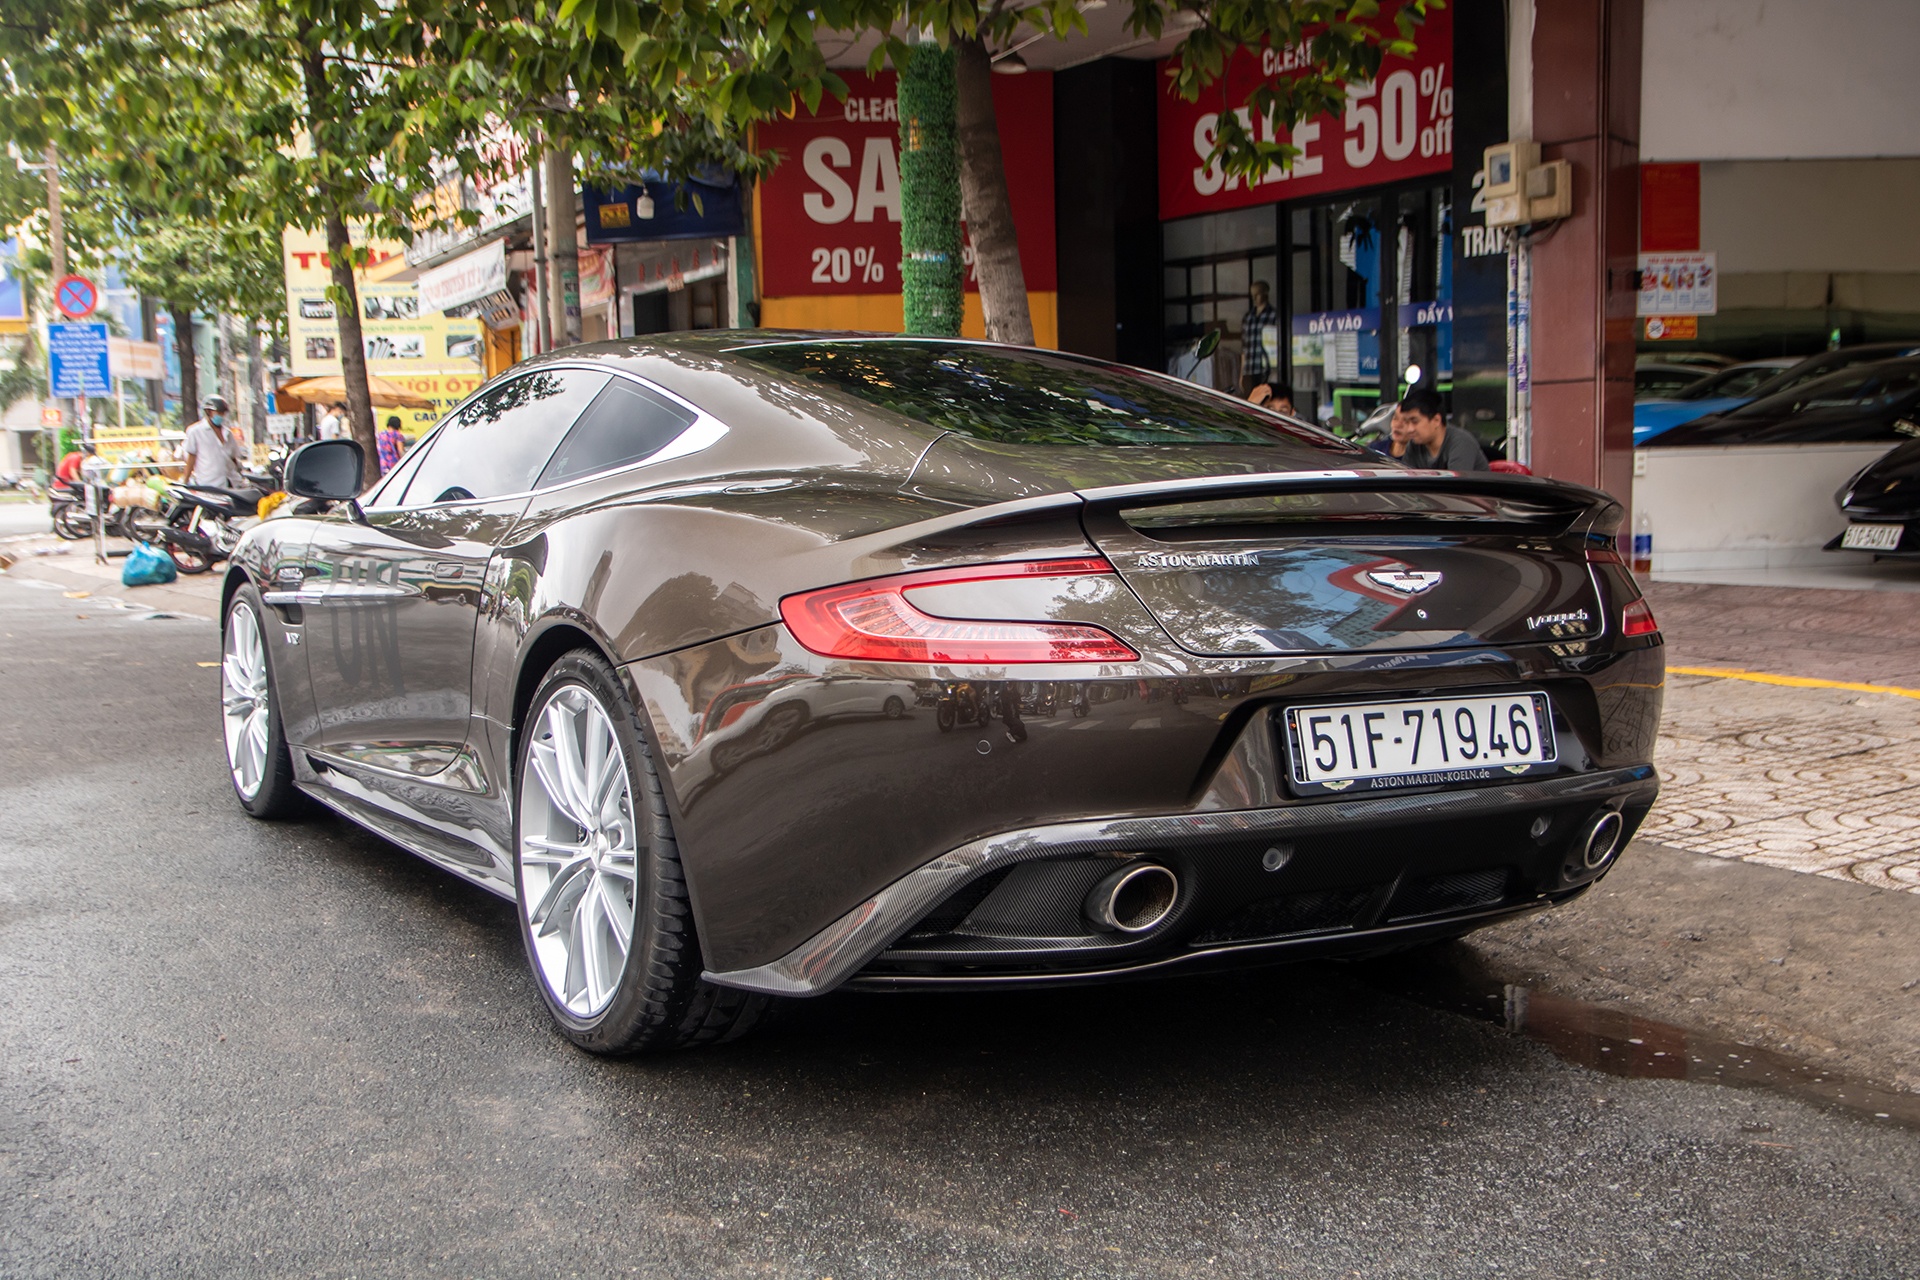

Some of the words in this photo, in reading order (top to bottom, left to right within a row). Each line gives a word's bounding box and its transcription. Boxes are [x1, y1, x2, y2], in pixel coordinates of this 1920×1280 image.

[844, 97, 901, 122] CLEA
[1420, 115, 1454, 158] off
[802, 136, 903, 225] SA
[811, 245, 885, 284] 20%
[445, 376, 484, 394] ÔT
[1137, 554, 1191, 568] ASTON
[1196, 553, 1260, 567] MARTIN
[1370, 775, 1405, 789] ASTON
[1406, 768, 1491, 786] MARTIN-KOELN.de
